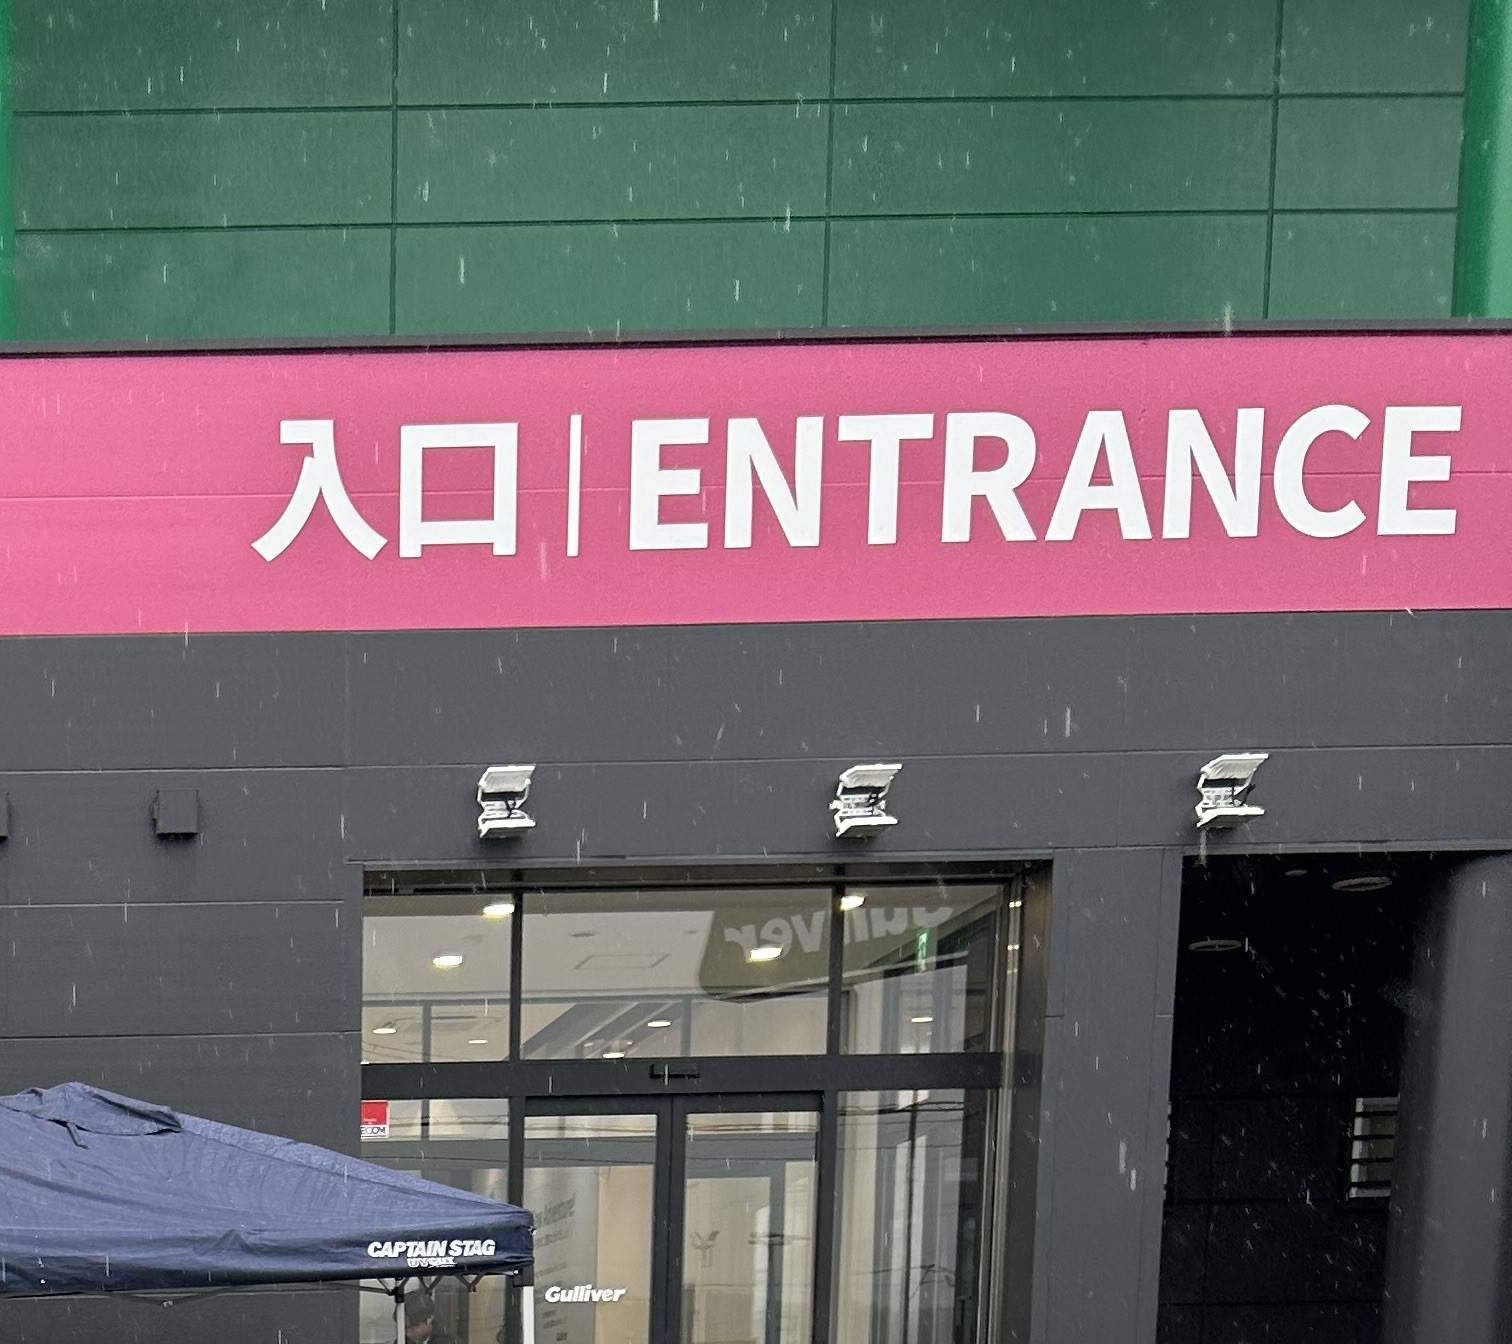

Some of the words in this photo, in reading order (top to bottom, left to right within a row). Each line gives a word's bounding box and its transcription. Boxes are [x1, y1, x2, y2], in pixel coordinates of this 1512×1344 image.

[251, 418, 519, 562] 入口
[629, 403, 1463, 551] ENTRANCE
[367, 1240, 447, 1258] CAPTAIN
[448, 1239, 496, 1257] STAG
[544, 1284, 628, 1303] Gulliver
